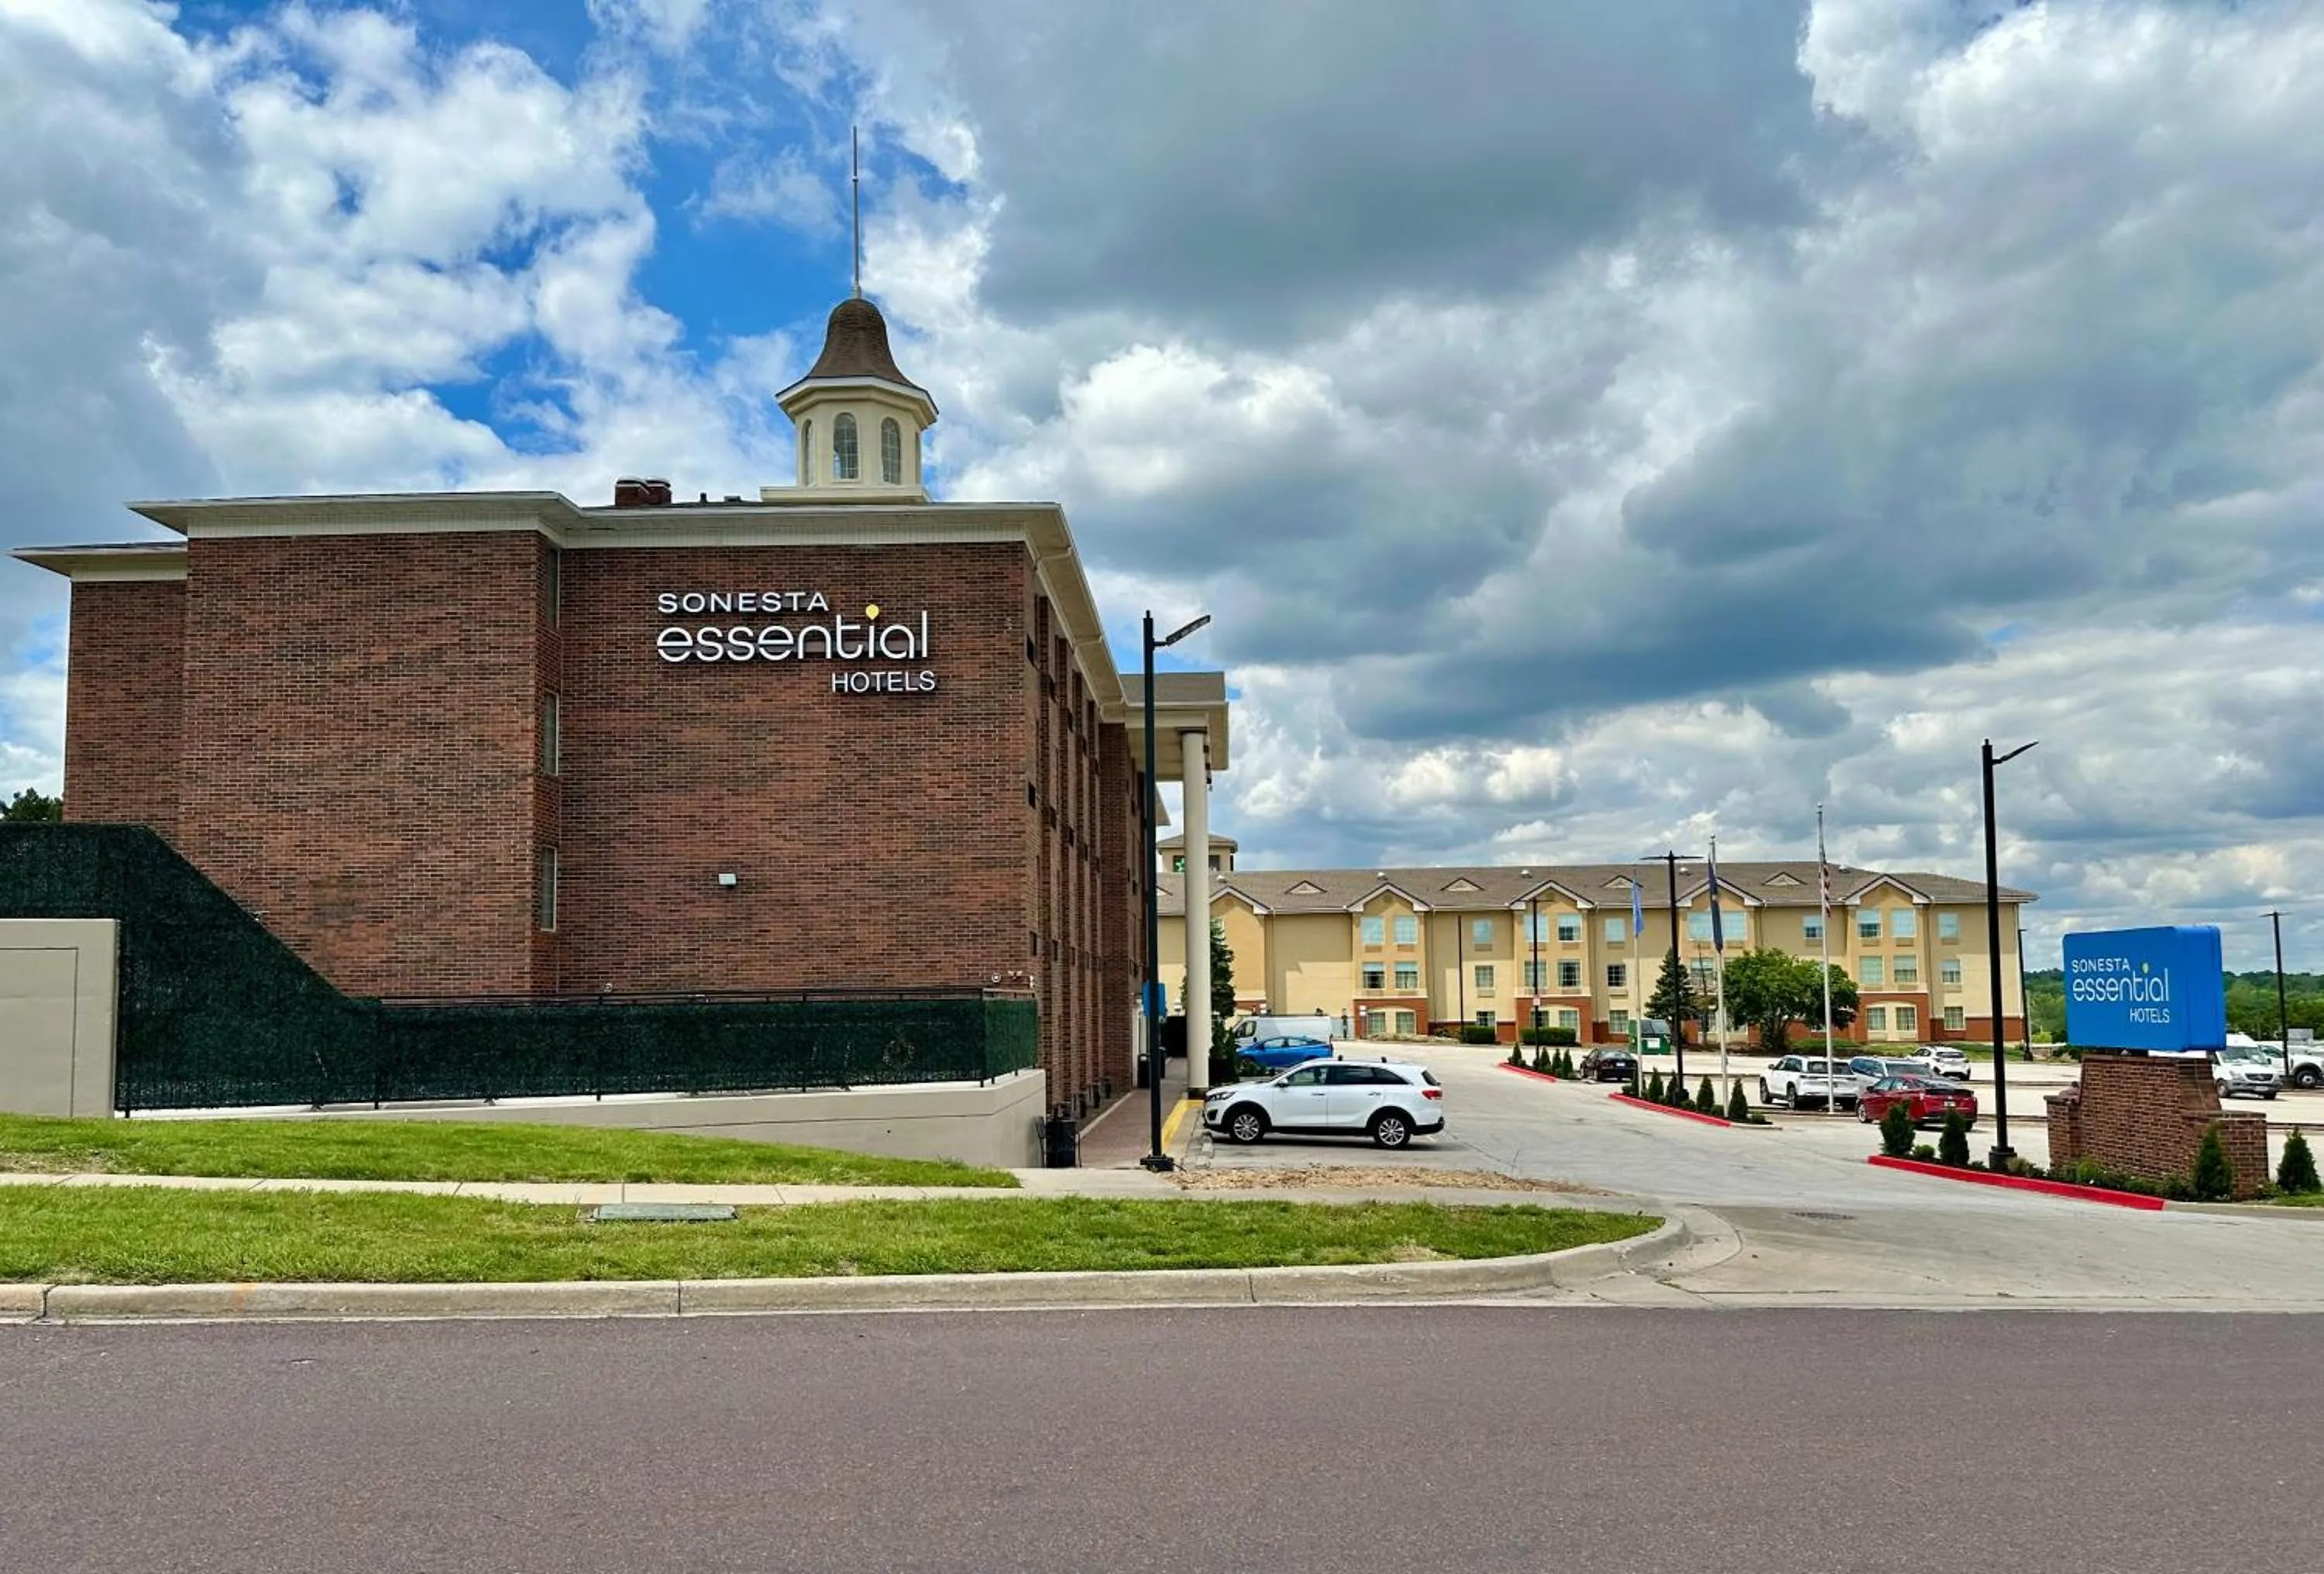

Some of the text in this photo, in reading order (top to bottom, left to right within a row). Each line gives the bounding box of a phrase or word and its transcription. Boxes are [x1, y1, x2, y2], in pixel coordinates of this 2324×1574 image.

[657, 591, 830, 613] SONESTA
[655, 603, 928, 662] essential
[831, 670, 937, 693] HOTELS
[2071, 957, 2131, 974] SONESTA
[2072, 962, 2170, 1002] essential
[2130, 1008, 2170, 1023] HOTELS
